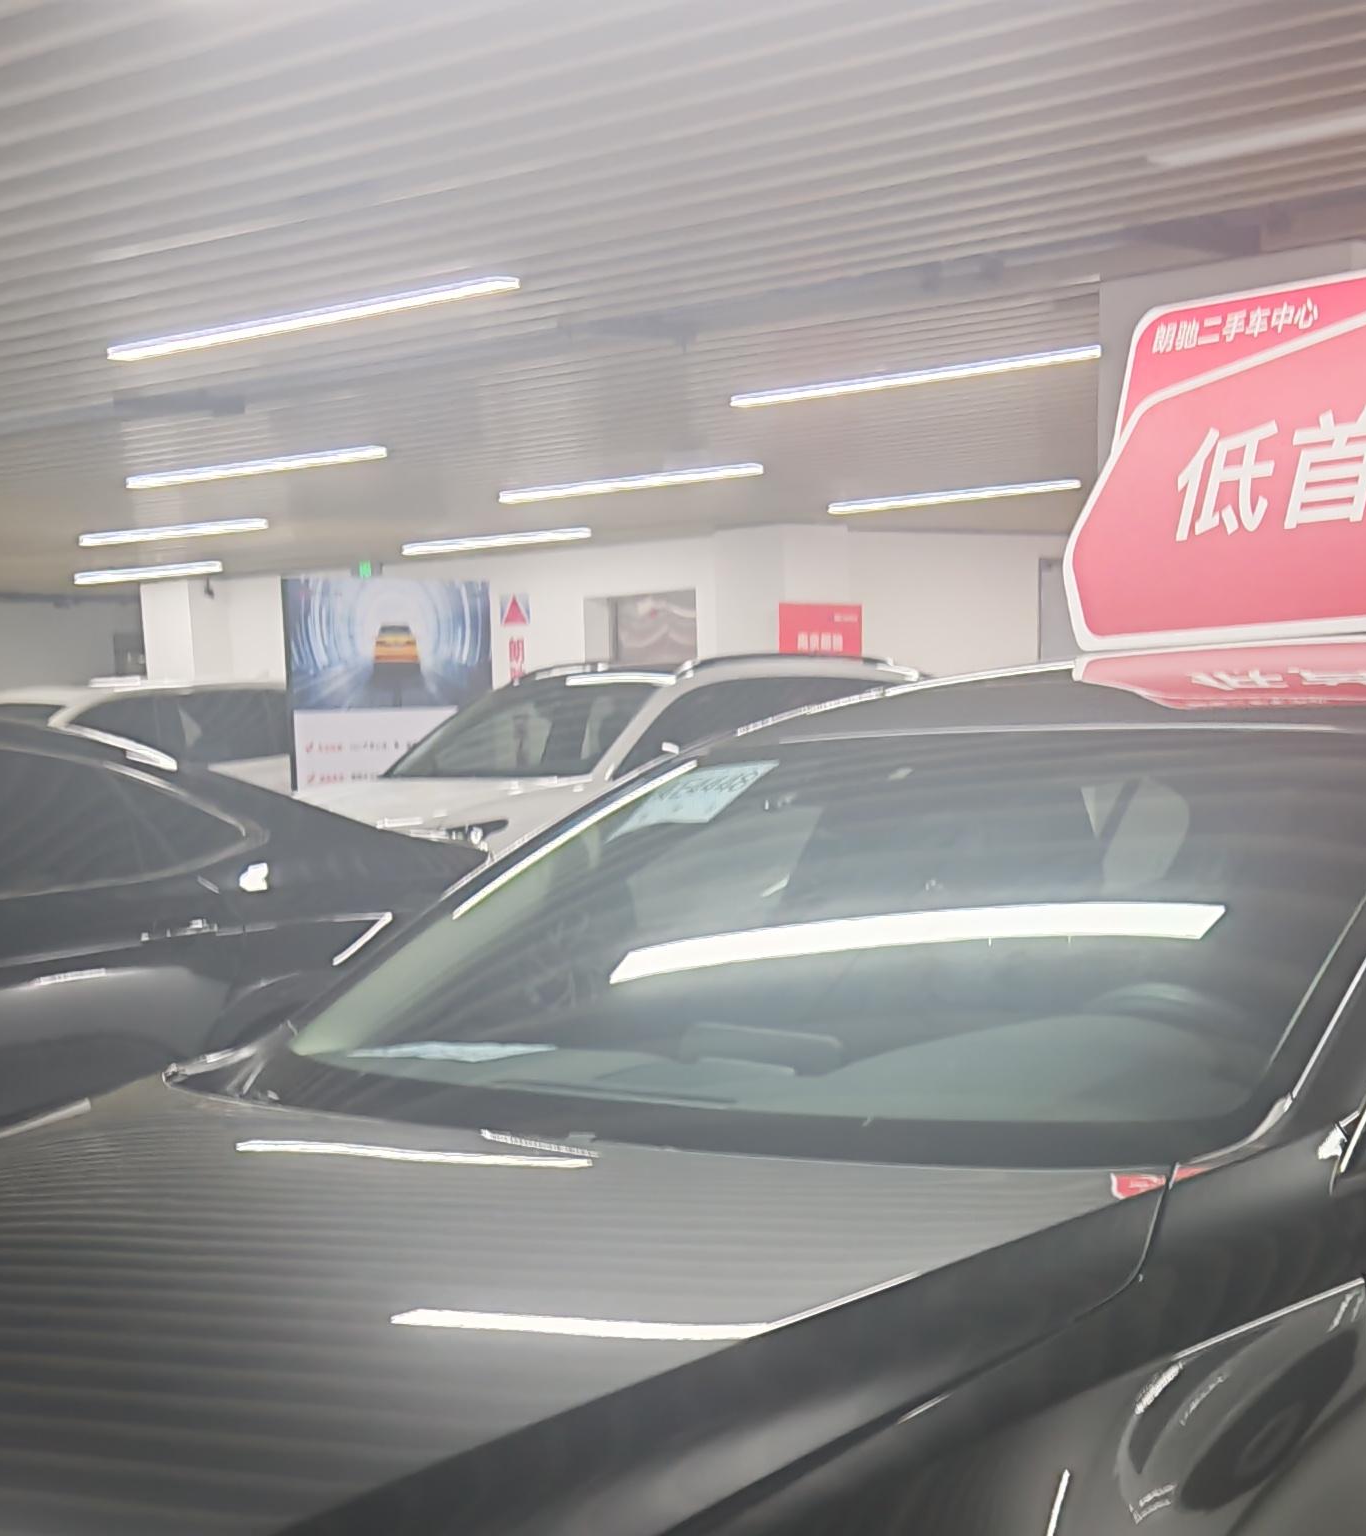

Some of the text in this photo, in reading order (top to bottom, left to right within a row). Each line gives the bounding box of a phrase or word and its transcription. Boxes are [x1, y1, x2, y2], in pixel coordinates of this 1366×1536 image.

[1151, 297, 1319, 354] 朗驰二手车中心
